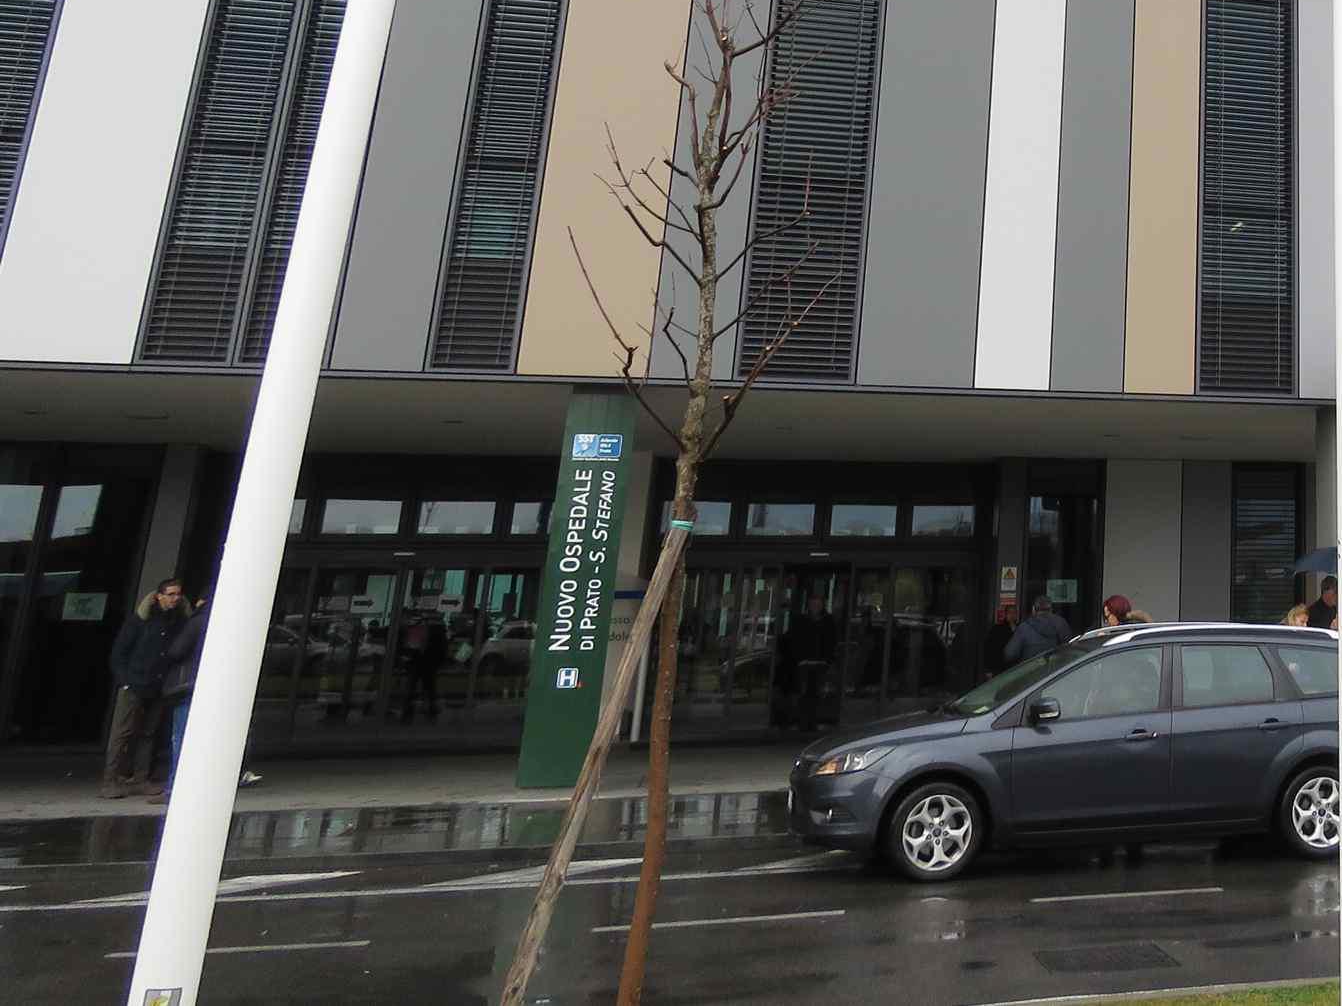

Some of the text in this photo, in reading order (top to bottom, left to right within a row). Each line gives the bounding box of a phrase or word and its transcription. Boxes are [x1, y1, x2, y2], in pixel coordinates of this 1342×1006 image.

[592, 470, 616, 542] STEFANO
[548, 470, 593, 651] NUOVO OSPEDALE
[589, 547, 607, 564] S.
[580, 580, 602, 630] PRATO
[559, 669, 576, 687] H
